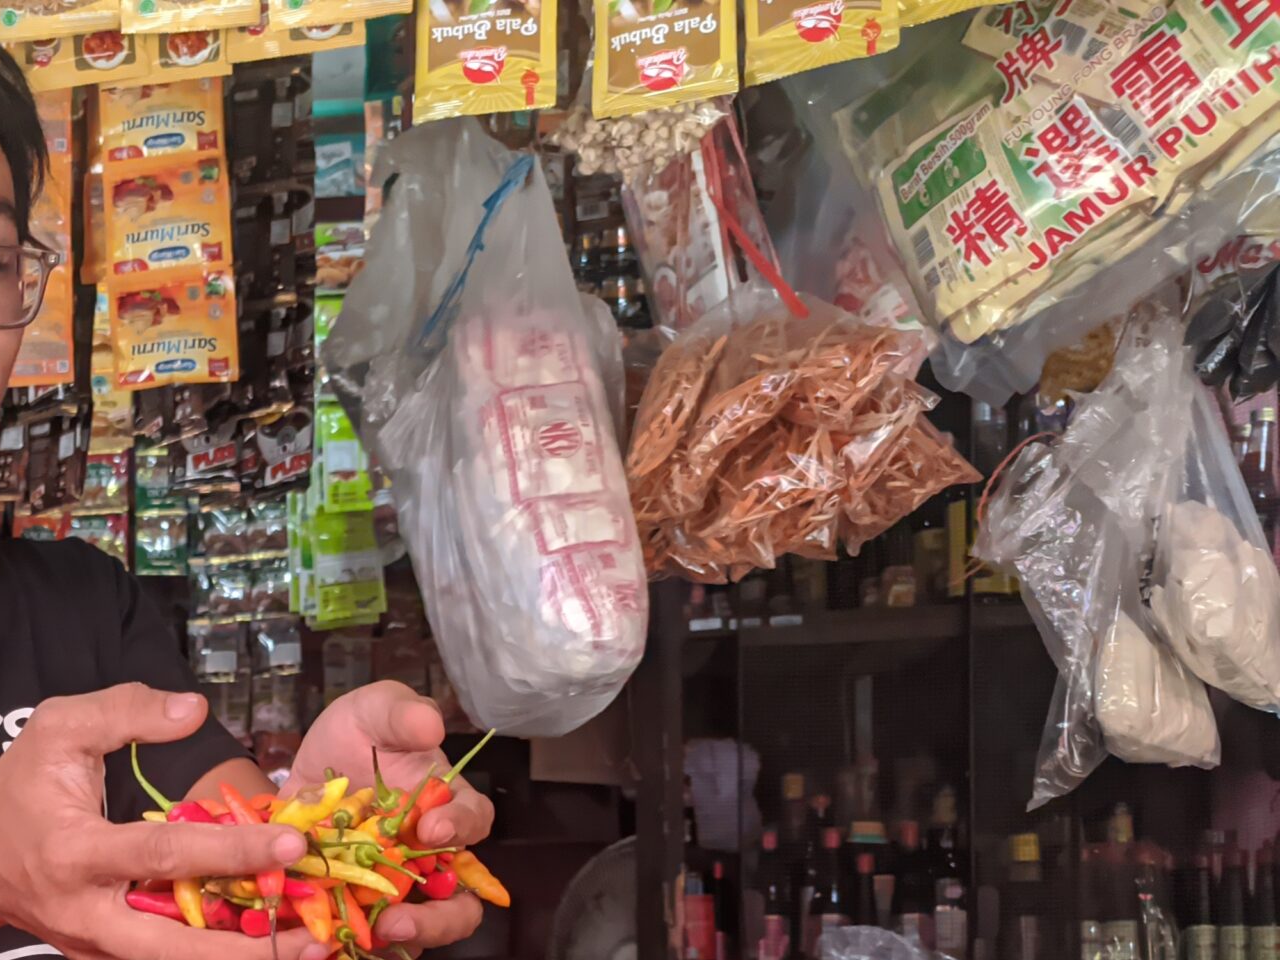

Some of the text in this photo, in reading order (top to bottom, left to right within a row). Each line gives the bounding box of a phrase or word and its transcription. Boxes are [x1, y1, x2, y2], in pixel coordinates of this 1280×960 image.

[431, 17, 538, 43] Pala Bubuk
[610, 12, 717, 52] Pala Bubuk
[1003, 5, 1166, 147] FU YOUNG FONG BRAND
[1029, 44, 1280, 272] JAMUR PUTIH
